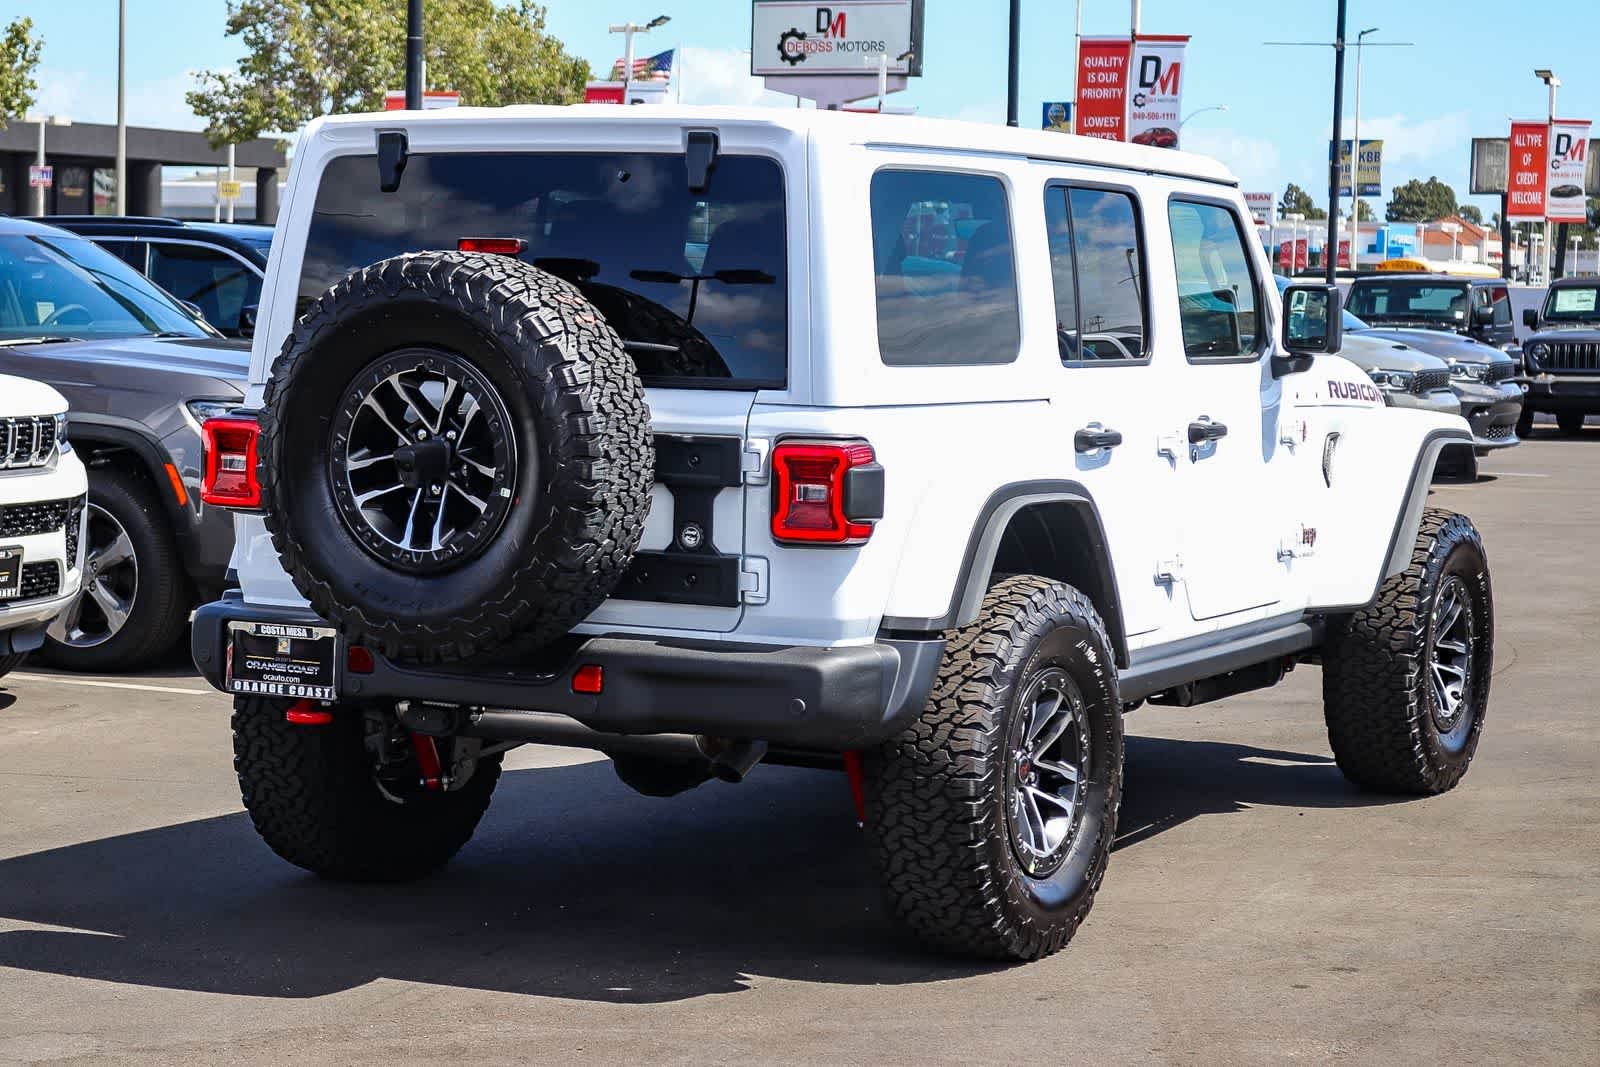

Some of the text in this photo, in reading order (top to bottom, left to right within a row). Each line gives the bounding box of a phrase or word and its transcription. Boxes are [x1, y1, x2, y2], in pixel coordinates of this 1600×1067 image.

[836, 40, 886, 53] MOTORS
[1084, 56, 1124, 67] QUALITY
[1087, 72, 1119, 84] IS OUR
[1081, 87, 1123, 99] PRIORITY
[1083, 116, 1120, 128] LOWEST
[1515, 134, 1542, 147] ALL TYPE
[1522, 153, 1533, 166] OF
[1516, 172, 1538, 185] CREDIT
[1512, 191, 1542, 204] WELCOME
[261, 625, 308, 637] COSTA MESA
[246, 661, 320, 675] ORANGE COAST
[263, 674, 300, 683] ocauto.com
[234, 681, 330, 698] ORANGE COAST
